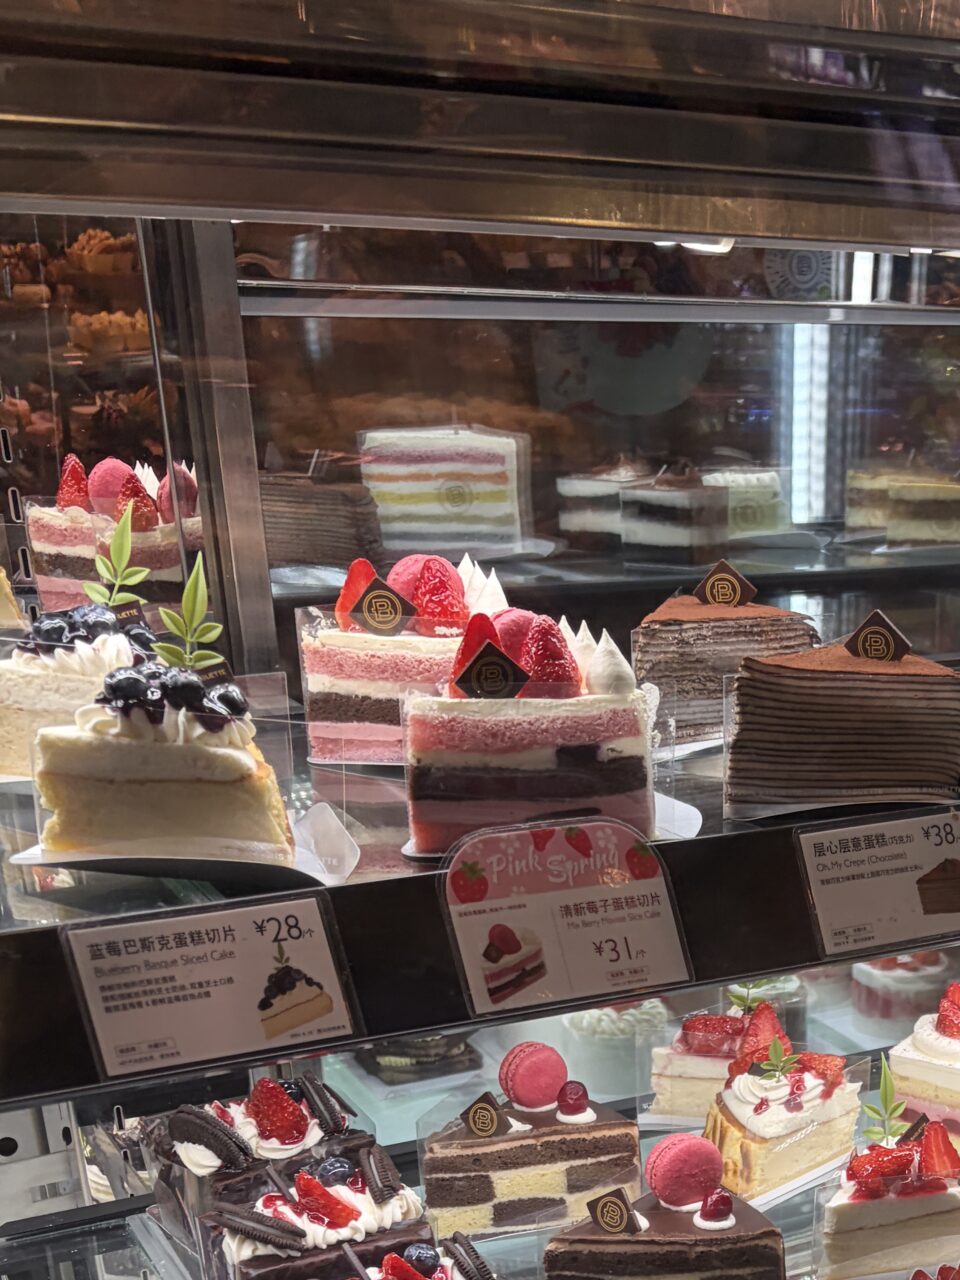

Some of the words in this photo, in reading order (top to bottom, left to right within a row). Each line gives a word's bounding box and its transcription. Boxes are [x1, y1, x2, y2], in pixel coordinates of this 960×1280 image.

[811, 828, 914, 858] 层心层意蛋糕(巧克力)
[487, 848, 542, 884] Pink
[546, 846, 620, 887] Spring
[558, 892, 663, 918] 清新莓子蛋糕切片
[86, 923, 238, 962] 蓝莓巴斯克蛋糕切片
[252, 911, 315, 945] ¥28/个
[93, 961, 142, 979] Blueberry
[142, 955, 179, 971] Basque
[179, 951, 208, 965] Sliced
[209, 947, 236, 960] Cake
